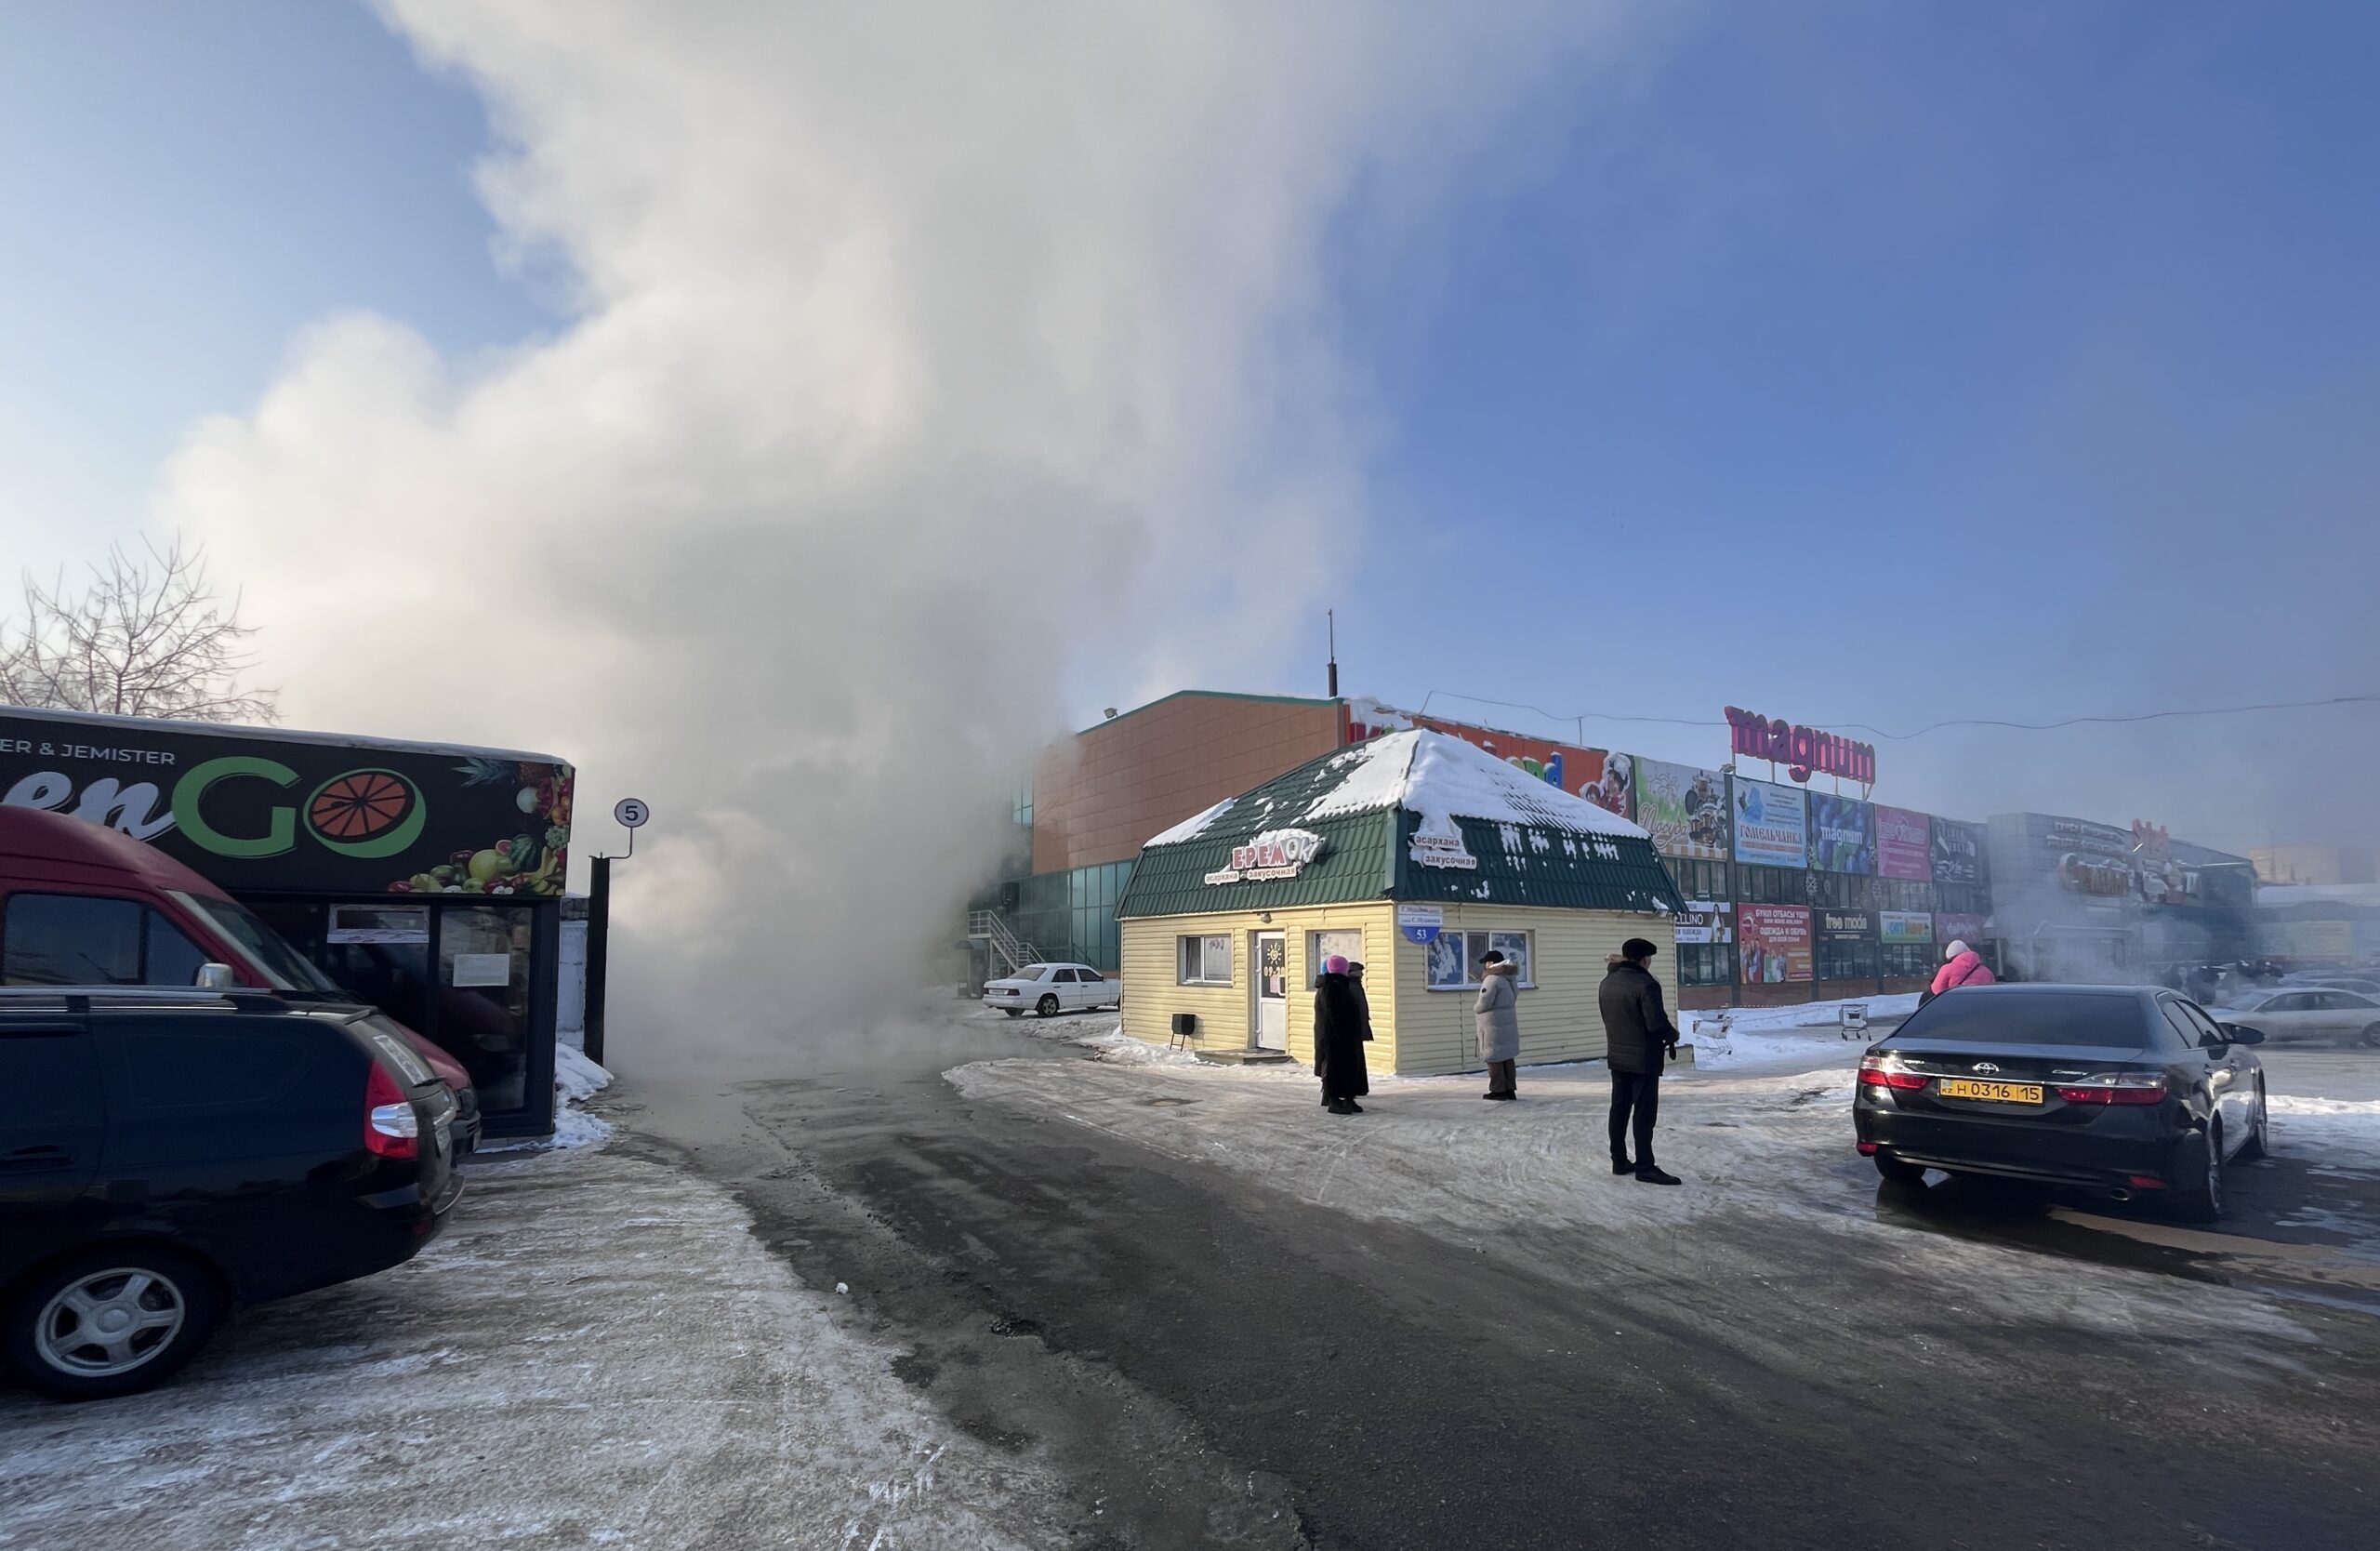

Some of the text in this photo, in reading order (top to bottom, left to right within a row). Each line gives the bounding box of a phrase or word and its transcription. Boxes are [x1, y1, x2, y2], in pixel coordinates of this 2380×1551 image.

[1725, 706, 1876, 783] magnum
[39, 742, 56, 757] &
[60, 744, 176, 766] JEMISTER
[624, 805, 639, 822] 5
[1639, 802, 1690, 849] Посуда
[1415, 836, 1460, 847] асархана
[1819, 826, 1863, 846] magnum
[1425, 855, 1475, 867] закусочная
[1249, 868, 1295, 878] закусочная
[1825, 912, 1867, 930] free moda
[1416, 929, 1427, 940] 53
[1957, 1084, 1967, 1095] H
[1971, 1082, 2010, 1098] 0316
[2020, 1087, 2040, 1101] 15
